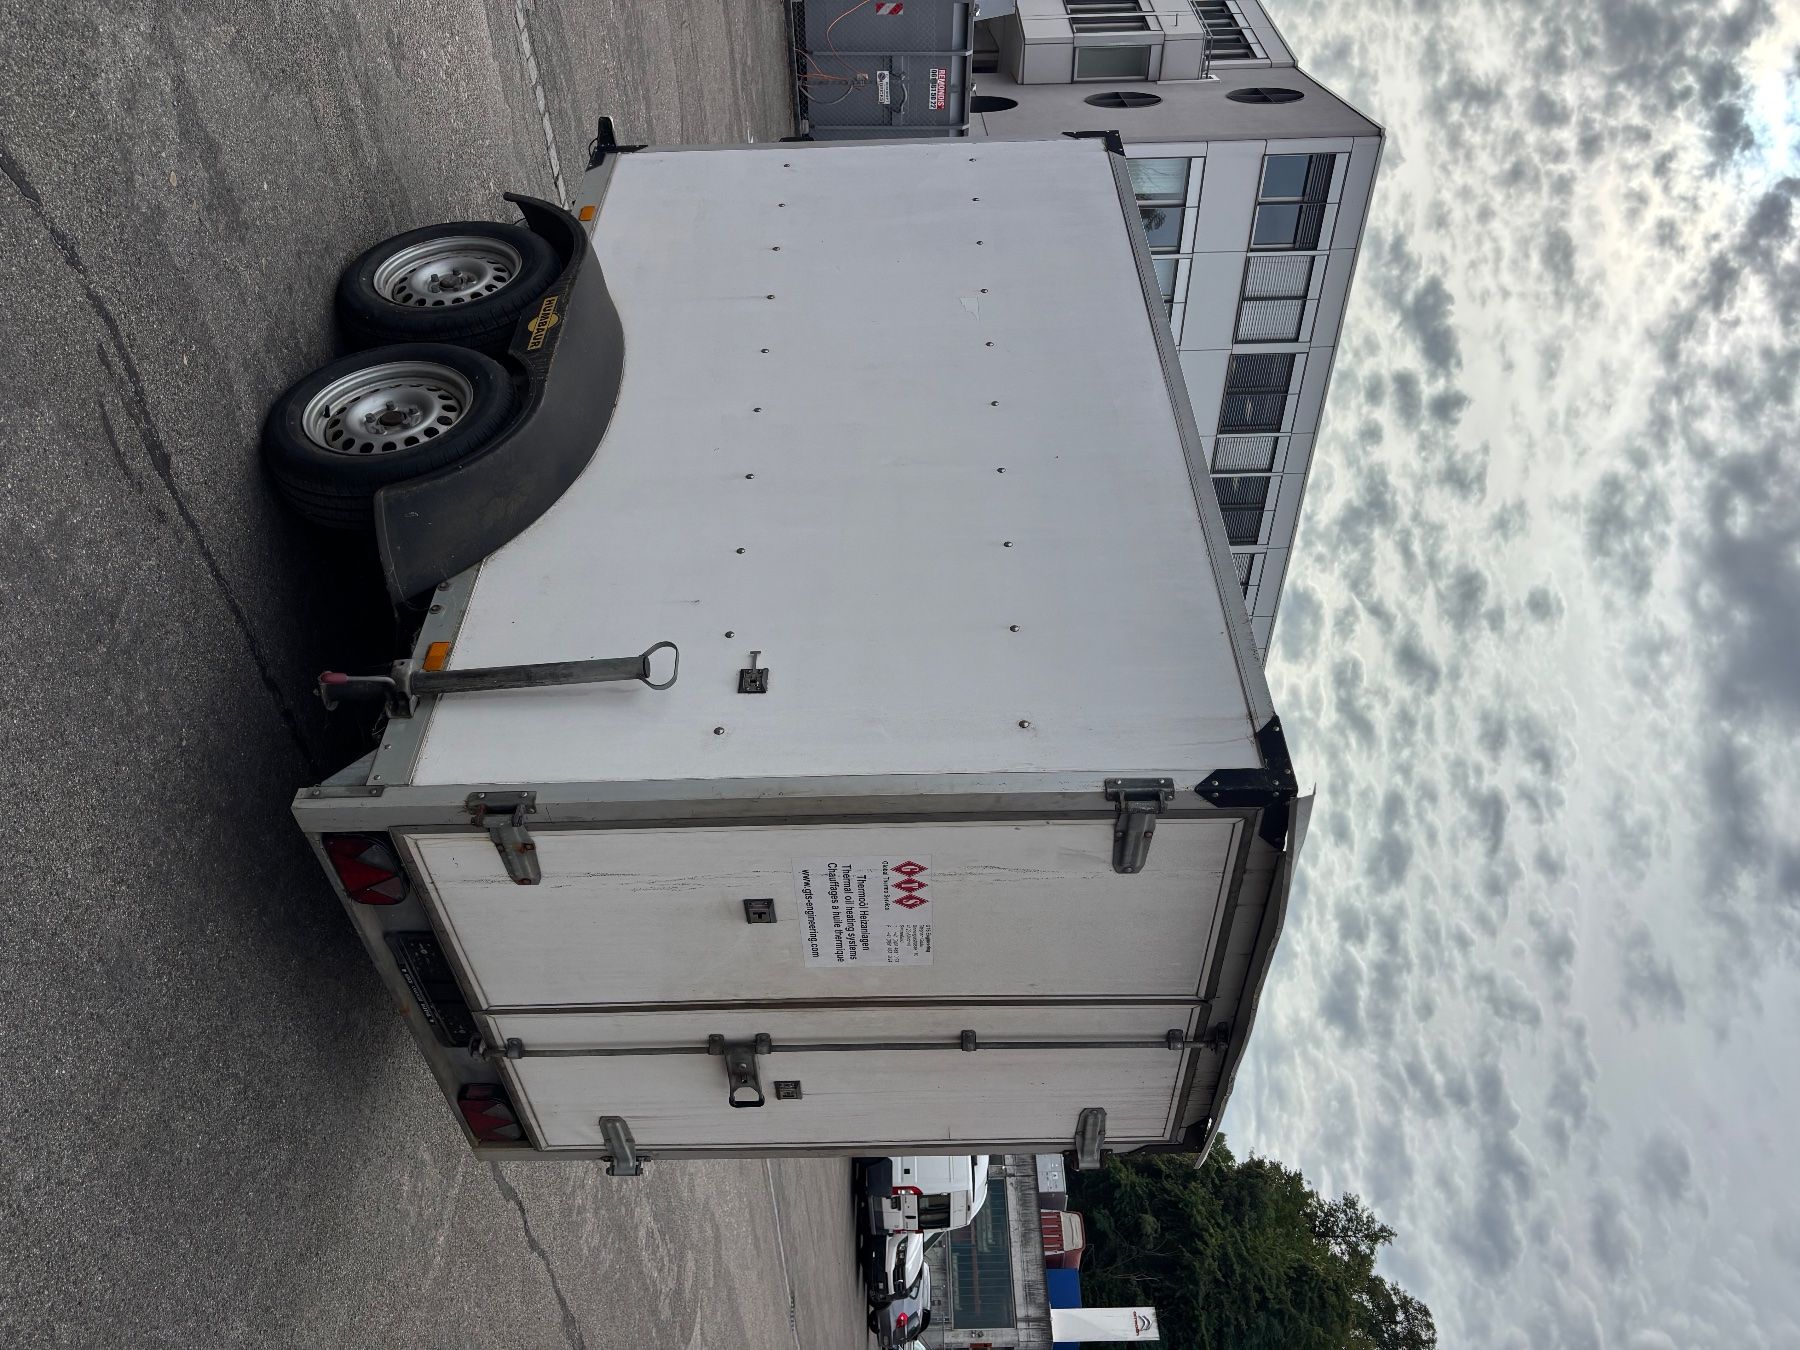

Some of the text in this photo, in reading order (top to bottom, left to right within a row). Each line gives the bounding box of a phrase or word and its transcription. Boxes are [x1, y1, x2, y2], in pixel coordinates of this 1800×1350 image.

[937, 69, 946, 107] REMONDIS
[530, 298, 555, 348] HUMBAUR
[827, 862, 839, 903] Chauffages
[801, 869, 819, 958] www.gts-engineering.com
[832, 911, 841, 928] huile
[841, 864, 857, 960] Thermal oil heating systems
[859, 910, 870, 951] Heizanlagen
[834, 928, 845, 963] thermique
